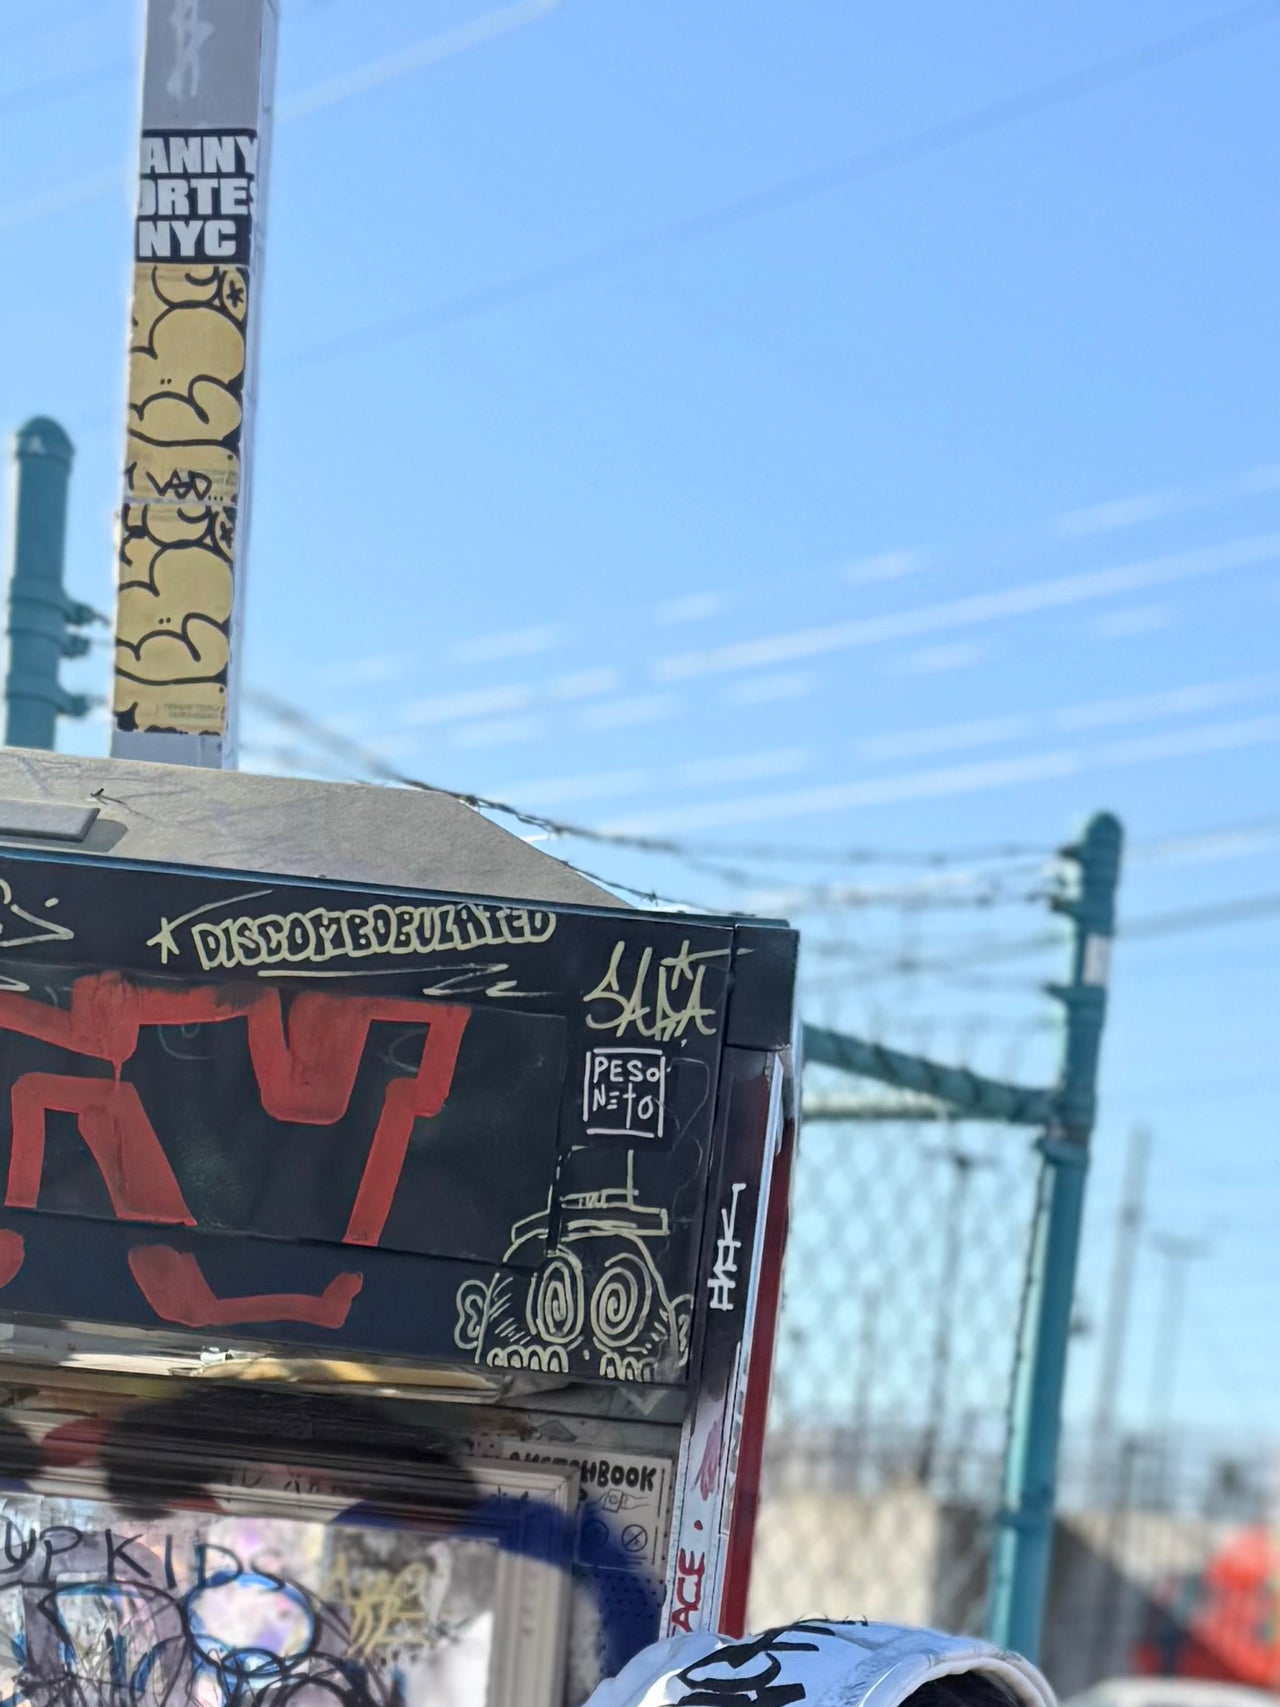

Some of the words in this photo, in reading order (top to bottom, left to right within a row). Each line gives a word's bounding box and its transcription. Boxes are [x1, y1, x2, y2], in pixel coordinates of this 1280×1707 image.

[139, 220, 236, 256] NYC
[191, 904, 557, 970] DISCOMBOBULATED
[592, 1056, 661, 1084] PESO
[593, 1083, 655, 1129] NETO
